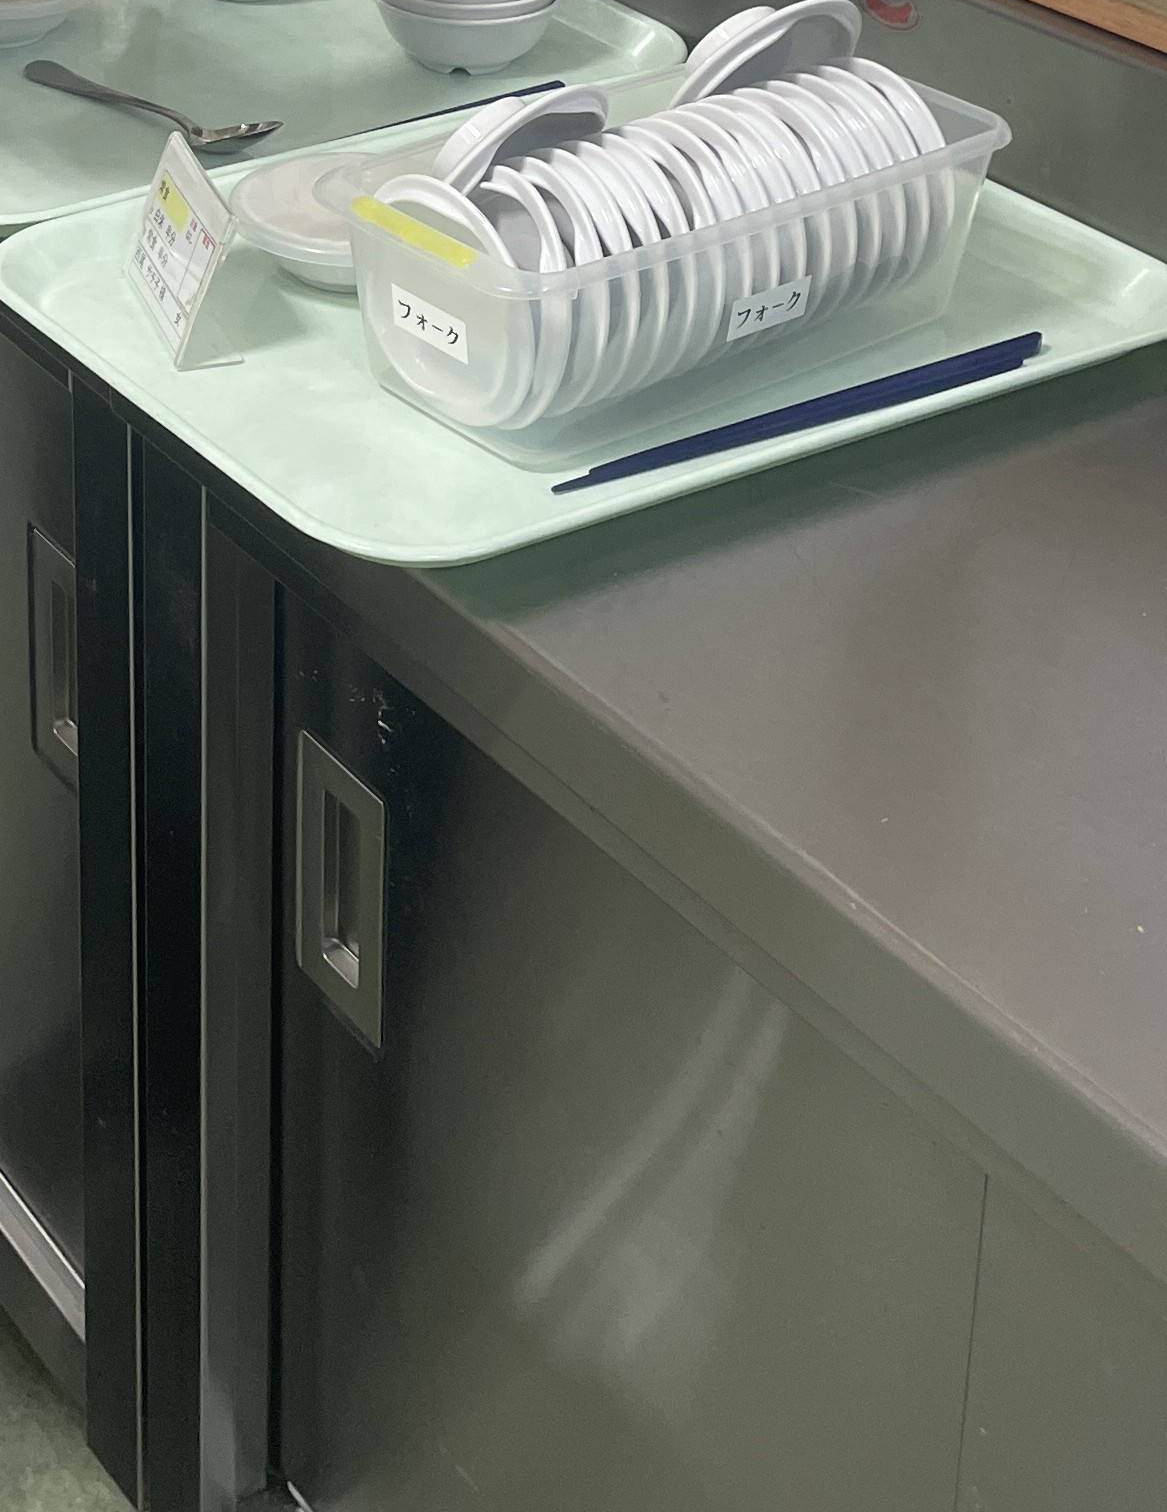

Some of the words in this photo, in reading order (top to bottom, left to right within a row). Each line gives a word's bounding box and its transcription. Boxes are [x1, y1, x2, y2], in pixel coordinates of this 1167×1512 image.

[398, 299, 459, 345] フォーク
[737, 291, 801, 328] フォーク
